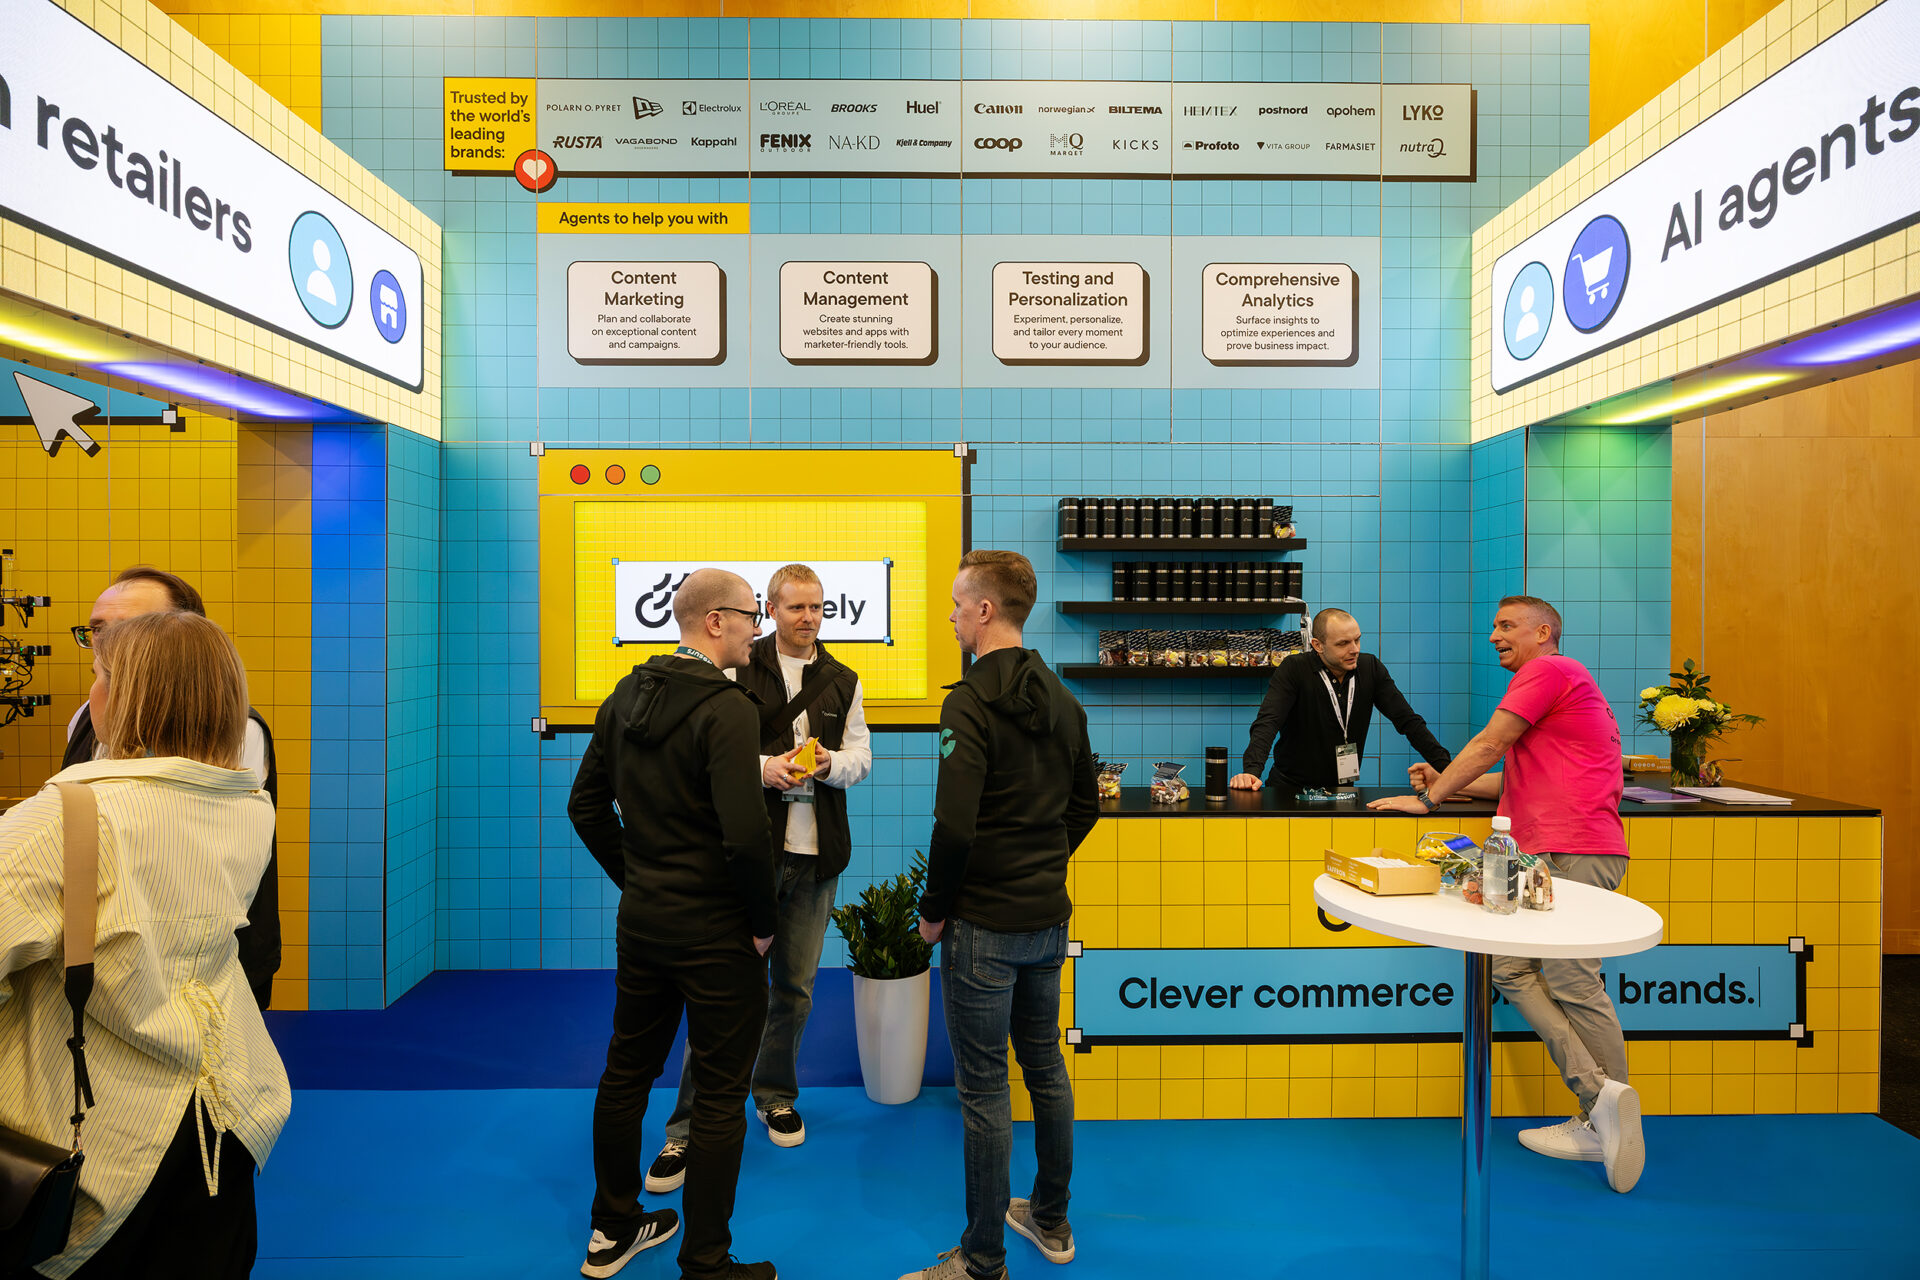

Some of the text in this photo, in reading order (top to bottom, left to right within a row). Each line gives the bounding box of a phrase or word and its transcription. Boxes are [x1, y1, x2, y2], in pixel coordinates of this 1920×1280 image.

[450, 91, 528, 107] Trusted by
[699, 104, 741, 112] Electrolux
[831, 104, 877, 112] BROOKS
[907, 101, 938, 114] Huel
[974, 103, 1022, 114] Canon
[1039, 106, 1085, 114] norwegian
[1109, 106, 1162, 114] BILTEMA
[1259, 106, 1308, 115] postnord
[1327, 105, 1375, 118] apohem
[450, 109, 475, 121] the
[451, 127, 504, 143] leading
[759, 133, 812, 148] FENIX
[553, 136, 602, 148] RUSTA
[691, 137, 736, 148] Kappahl
[828, 135, 881, 150] NA-KD
[896, 139, 912, 147] Kjell
[974, 138, 1022, 152] coop
[1112, 139, 1159, 150] KICKS
[1196, 141, 1239, 150] Profoto
[451, 146, 504, 158] brands:
[36, 95, 252, 253] retailers
[1661, 86, 1920, 263] AI agents
[559, 212, 727, 227] Agents to help you with
[612, 271, 676, 284] Content
[823, 271, 888, 284] Content
[1022, 271, 1113, 288] Testing and
[1216, 273, 1340, 289] Comprehensive
[605, 292, 683, 309] Marketing
[804, 292, 908, 308] Management
[1009, 292, 1127, 306] Personalization
[1242, 293, 1313, 310] Analytics
[598, 314, 691, 323] Plan and collaborate
[819, 314, 892, 325] Create stunning
[1236, 316, 1271, 324] Surface
[1274, 316, 1308, 326] insights
[606, 328, 658, 337] exceptional
[661, 328, 696, 336] content
[803, 327, 843, 335] websites
[865, 329, 887, 337] apps
[1013, 328, 1030, 336] and
[1033, 328, 1055, 336] tailor
[1058, 330, 1083, 338] every
[1221, 329, 1334, 338] optimize experiences and
[609, 340, 680, 350] and campaigns.
[805, 340, 908, 350] marketer-friendly tools.
[1064, 341, 1107, 349] audience.
[1227, 341, 1329, 351] prove business impact.
[1119, 977, 1243, 1009] Clever
[1254, 983, 1454, 1008] commerce
[1619, 973, 1754, 1004] brands.
